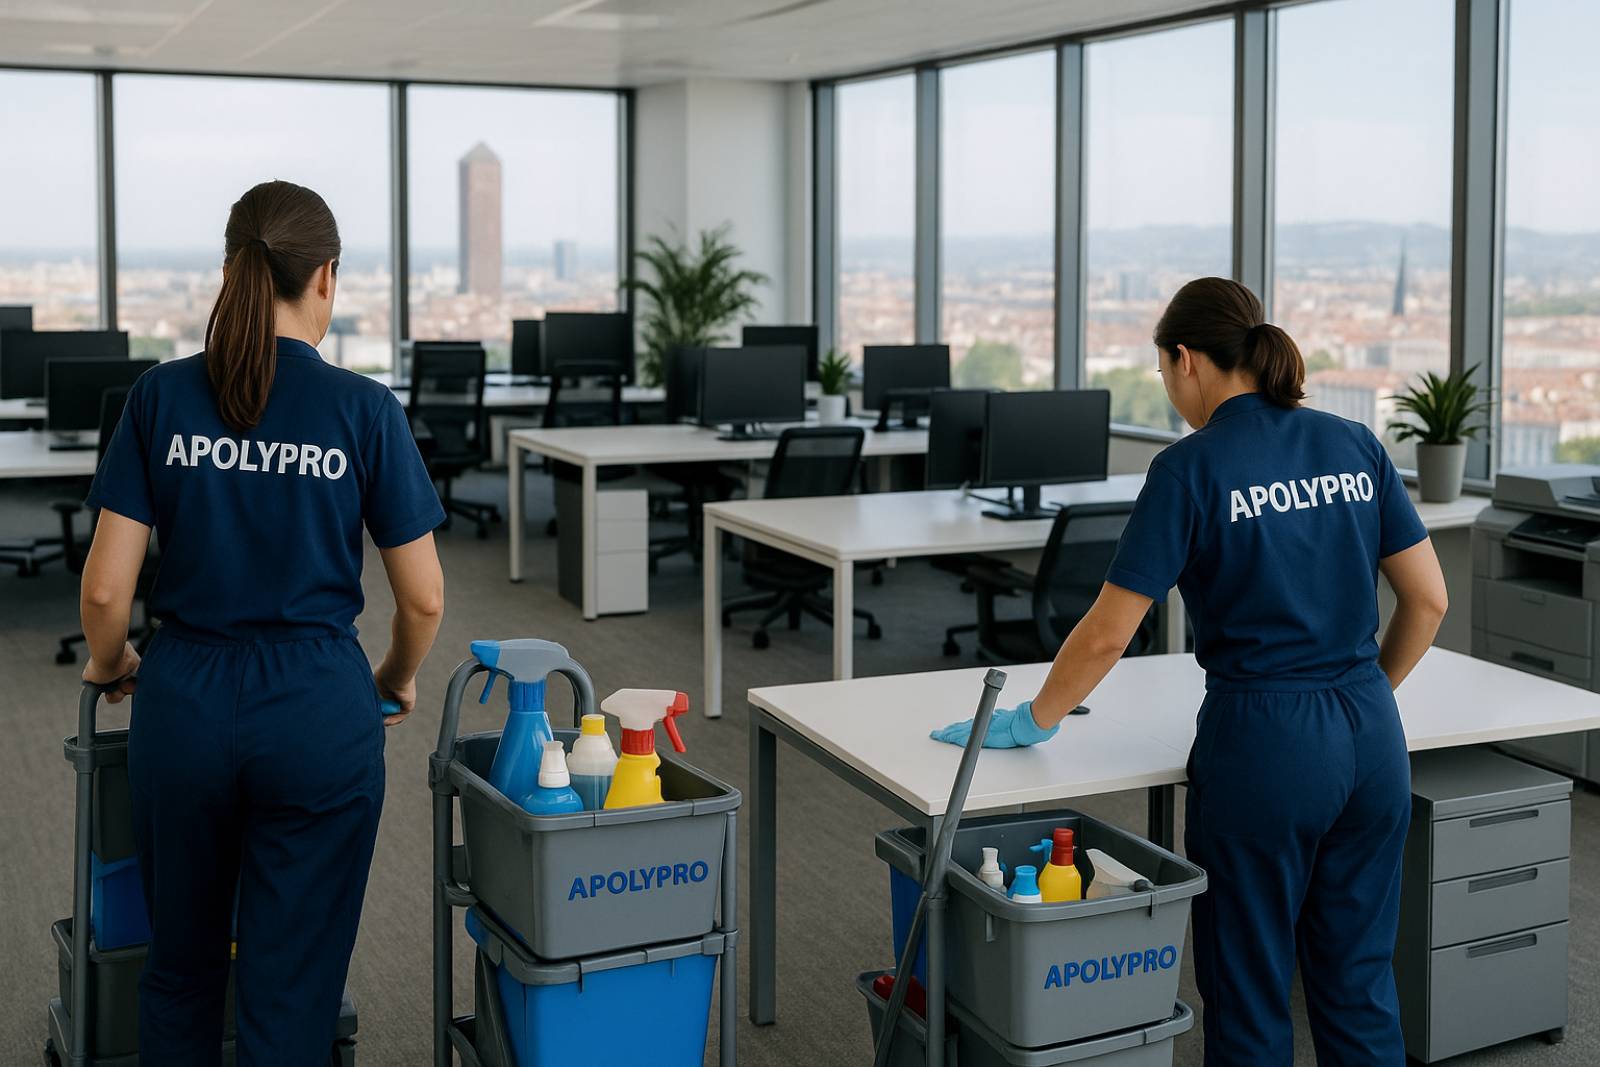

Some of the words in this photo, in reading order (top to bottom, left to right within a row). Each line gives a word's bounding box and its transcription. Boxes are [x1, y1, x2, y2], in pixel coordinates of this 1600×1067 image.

[166, 434, 348, 480] APOLYPRO
[1230, 471, 1375, 523] APOLYPRO
[568, 860, 709, 901] APOLYPRO
[1044, 944, 1178, 989] APOLYPRO
